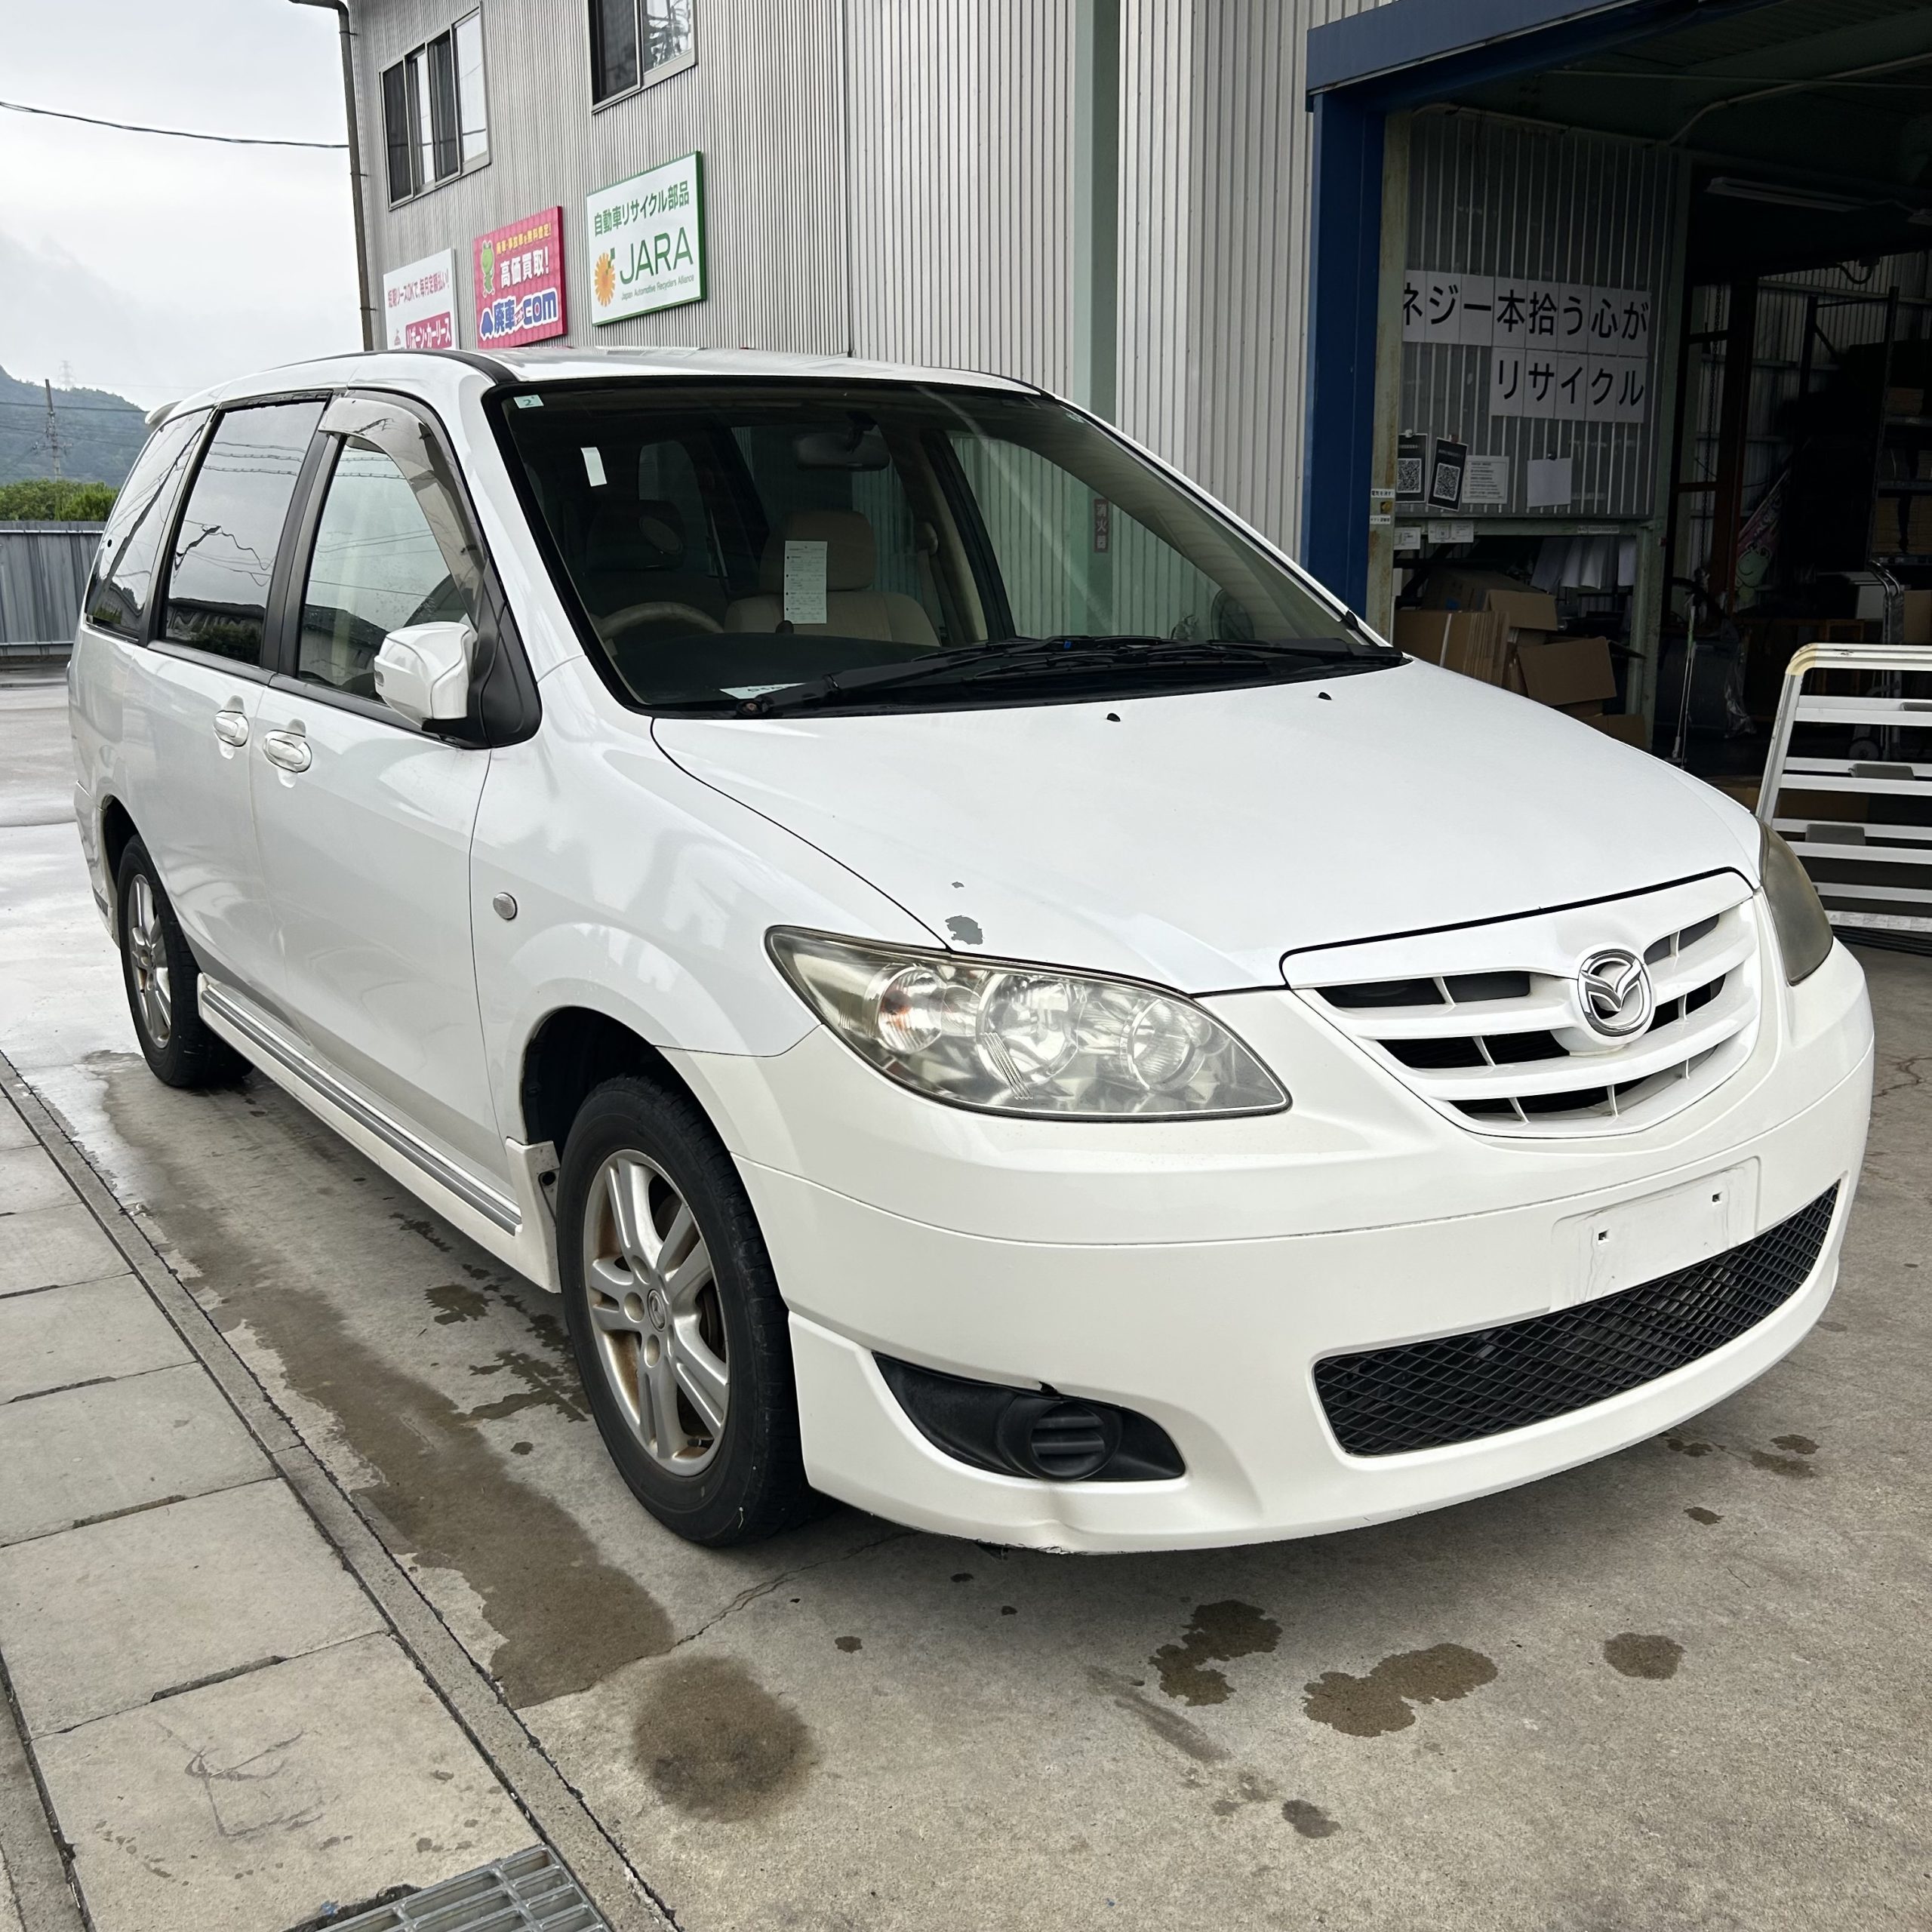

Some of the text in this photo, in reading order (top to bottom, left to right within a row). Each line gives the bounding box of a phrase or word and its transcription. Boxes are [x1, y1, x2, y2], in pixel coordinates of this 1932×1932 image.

[594, 180, 689, 237] 自動車リサイクル部品
[500, 246, 549, 288] 高価買取!
[620, 226, 694, 285] JARA
[634, 285, 657, 297] Automotive
[657, 279, 677, 291] Recyclers
[678, 274, 694, 285] Alliance
[1498, 360, 1644, 407] リサイクル
[1097, 504, 1107, 549] 消火器
